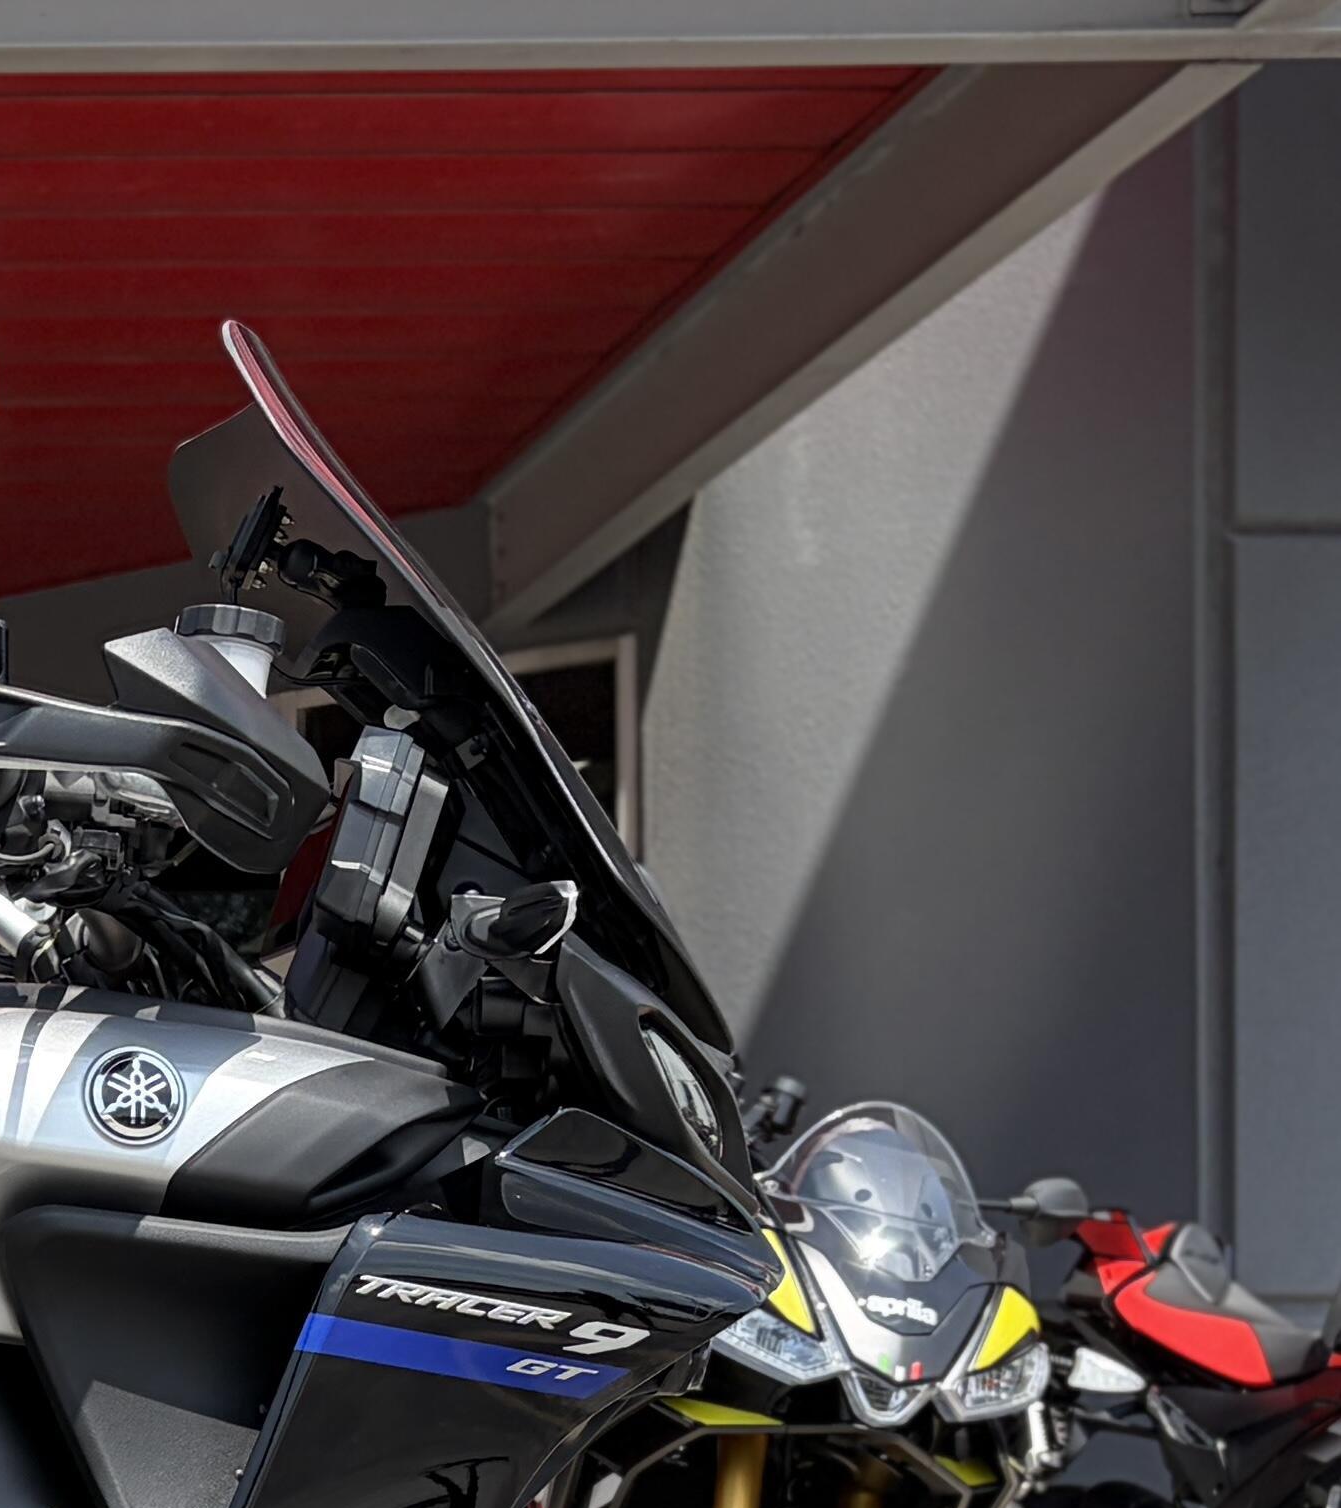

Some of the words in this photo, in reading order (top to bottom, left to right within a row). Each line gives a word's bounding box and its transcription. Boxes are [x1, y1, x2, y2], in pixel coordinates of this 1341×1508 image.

[355, 1274, 573, 1330] TRACER
[562, 1321, 651, 1355] 9
[506, 1358, 599, 1381] GT
